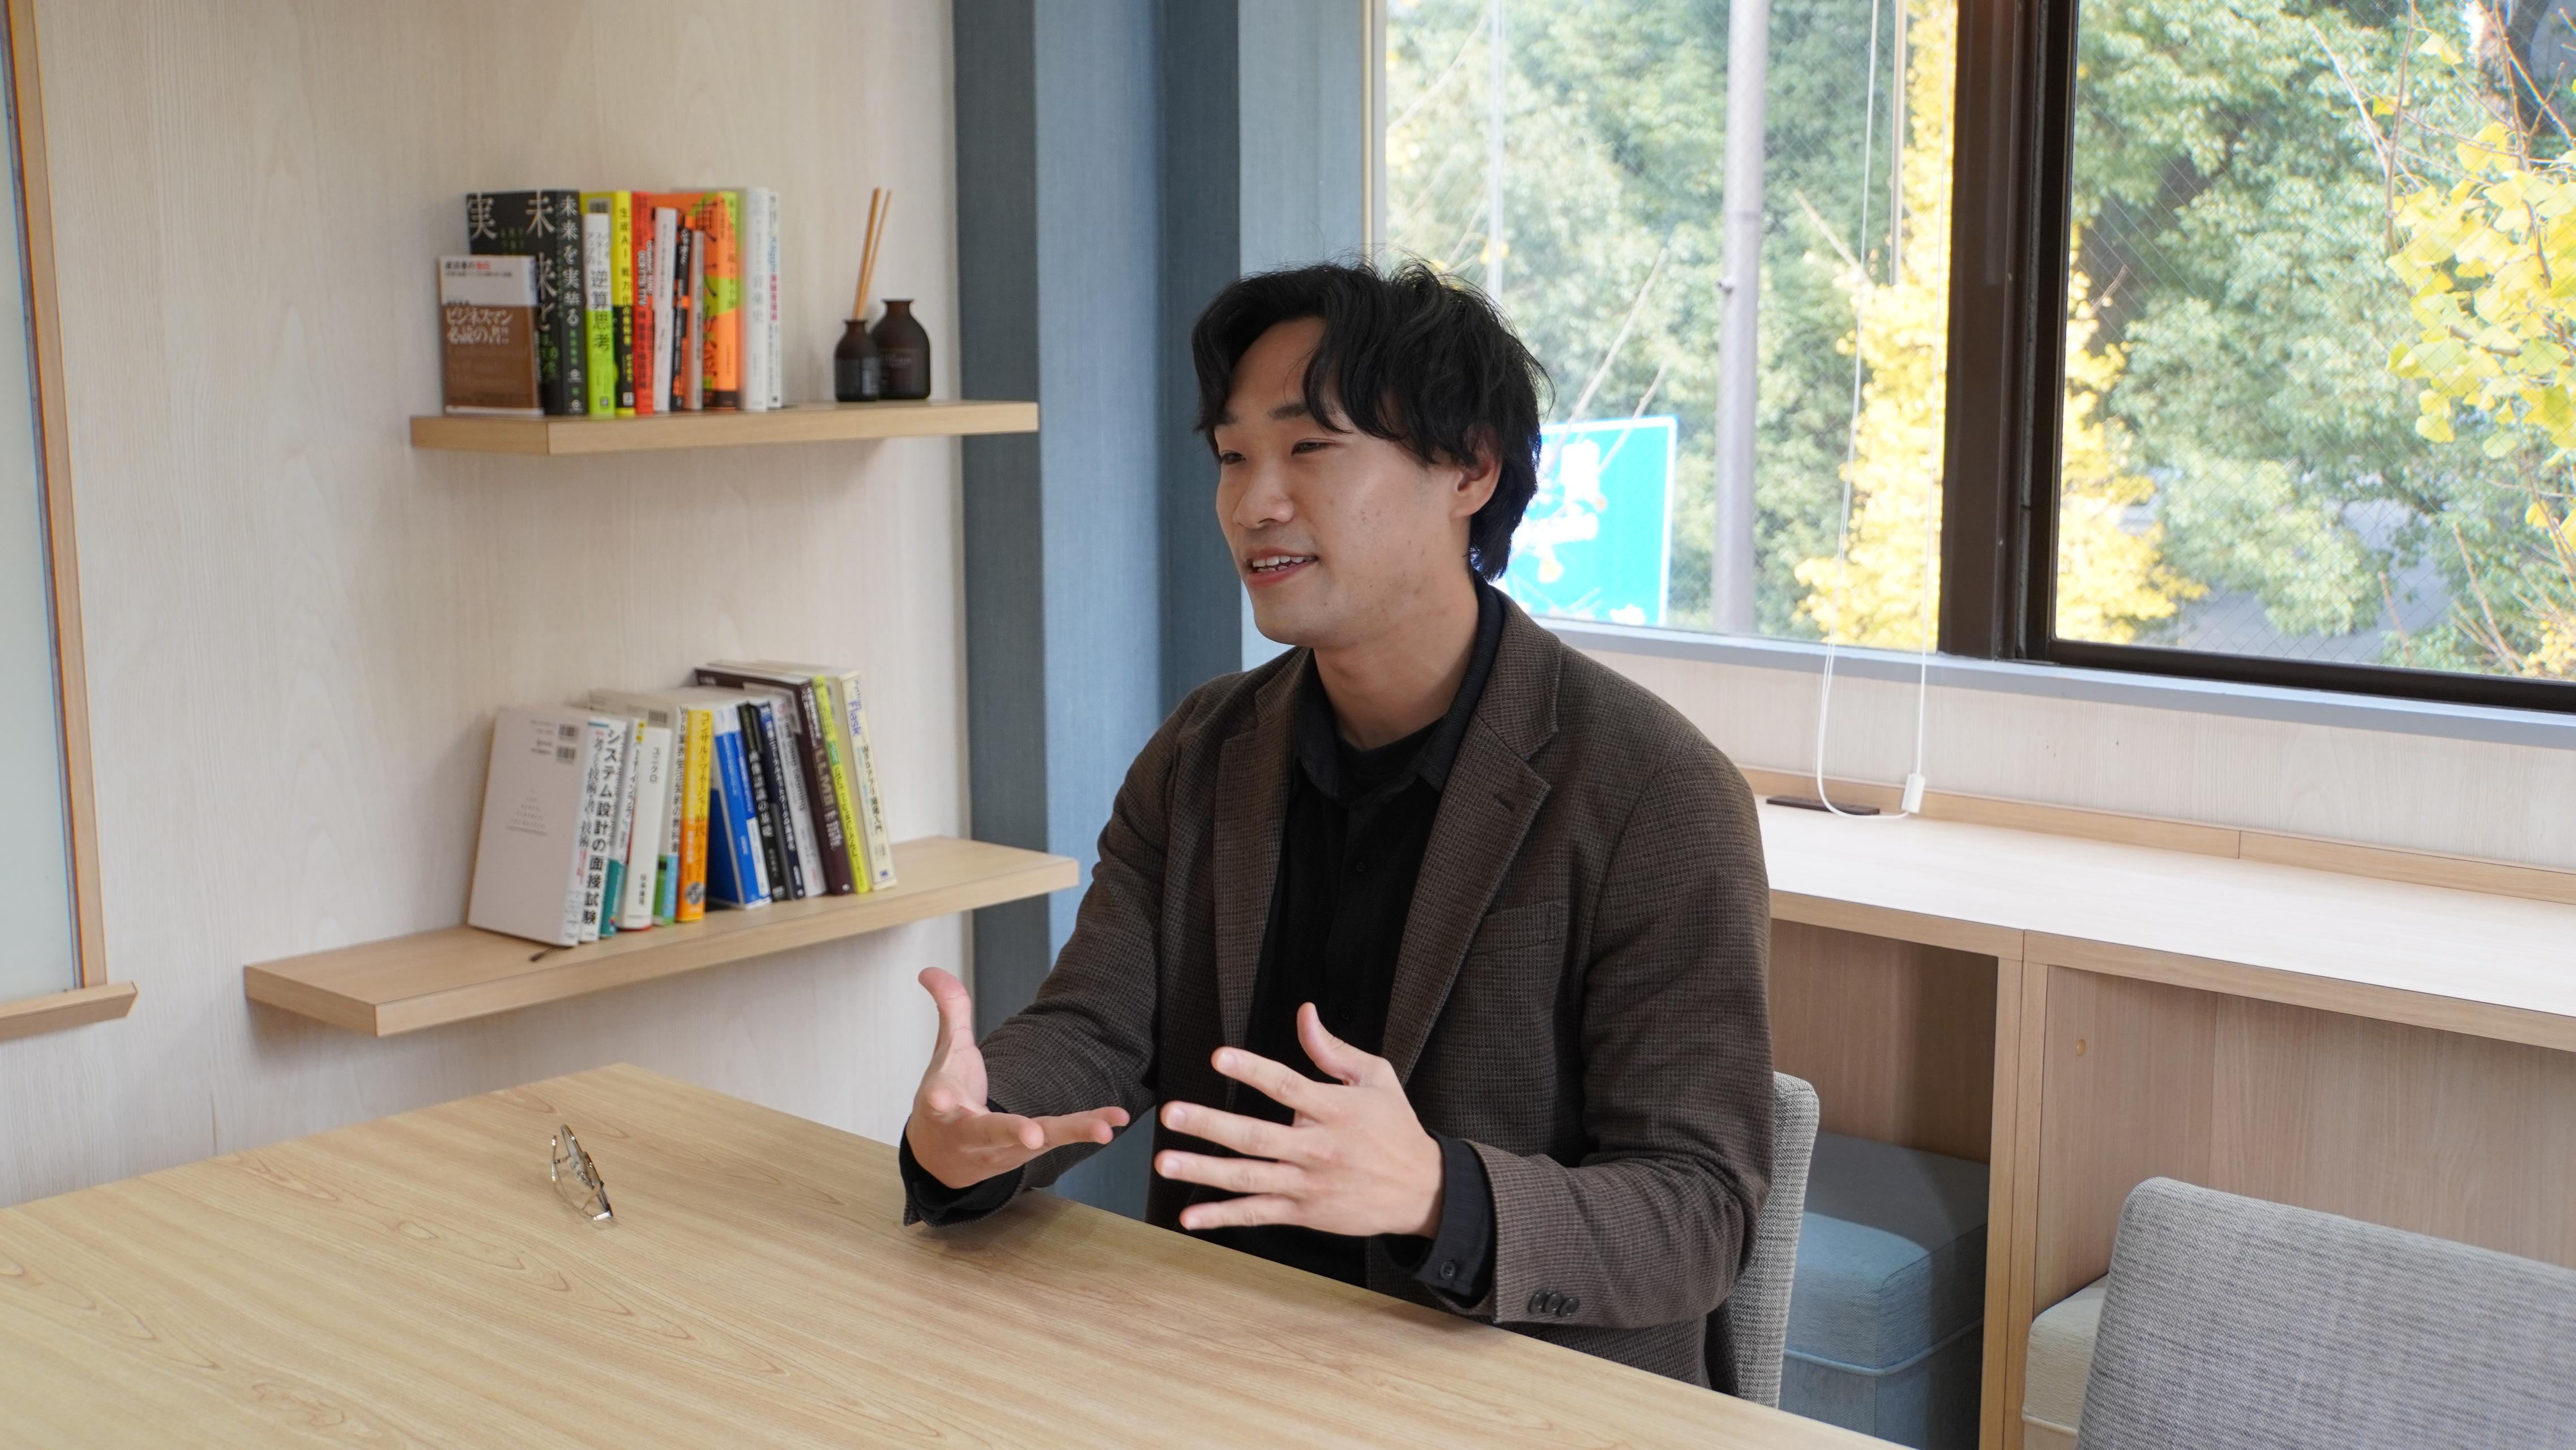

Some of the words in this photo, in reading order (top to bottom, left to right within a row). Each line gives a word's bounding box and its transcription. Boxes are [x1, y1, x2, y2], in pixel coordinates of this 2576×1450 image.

[560, 195, 580, 326] 未来を実装する
[590, 270, 610, 351] 逆算思考
[848, 700, 861, 736] Flask
[650, 747, 661, 783] ユニクロ
[582, 729, 621, 924] システム設計の面接試験
